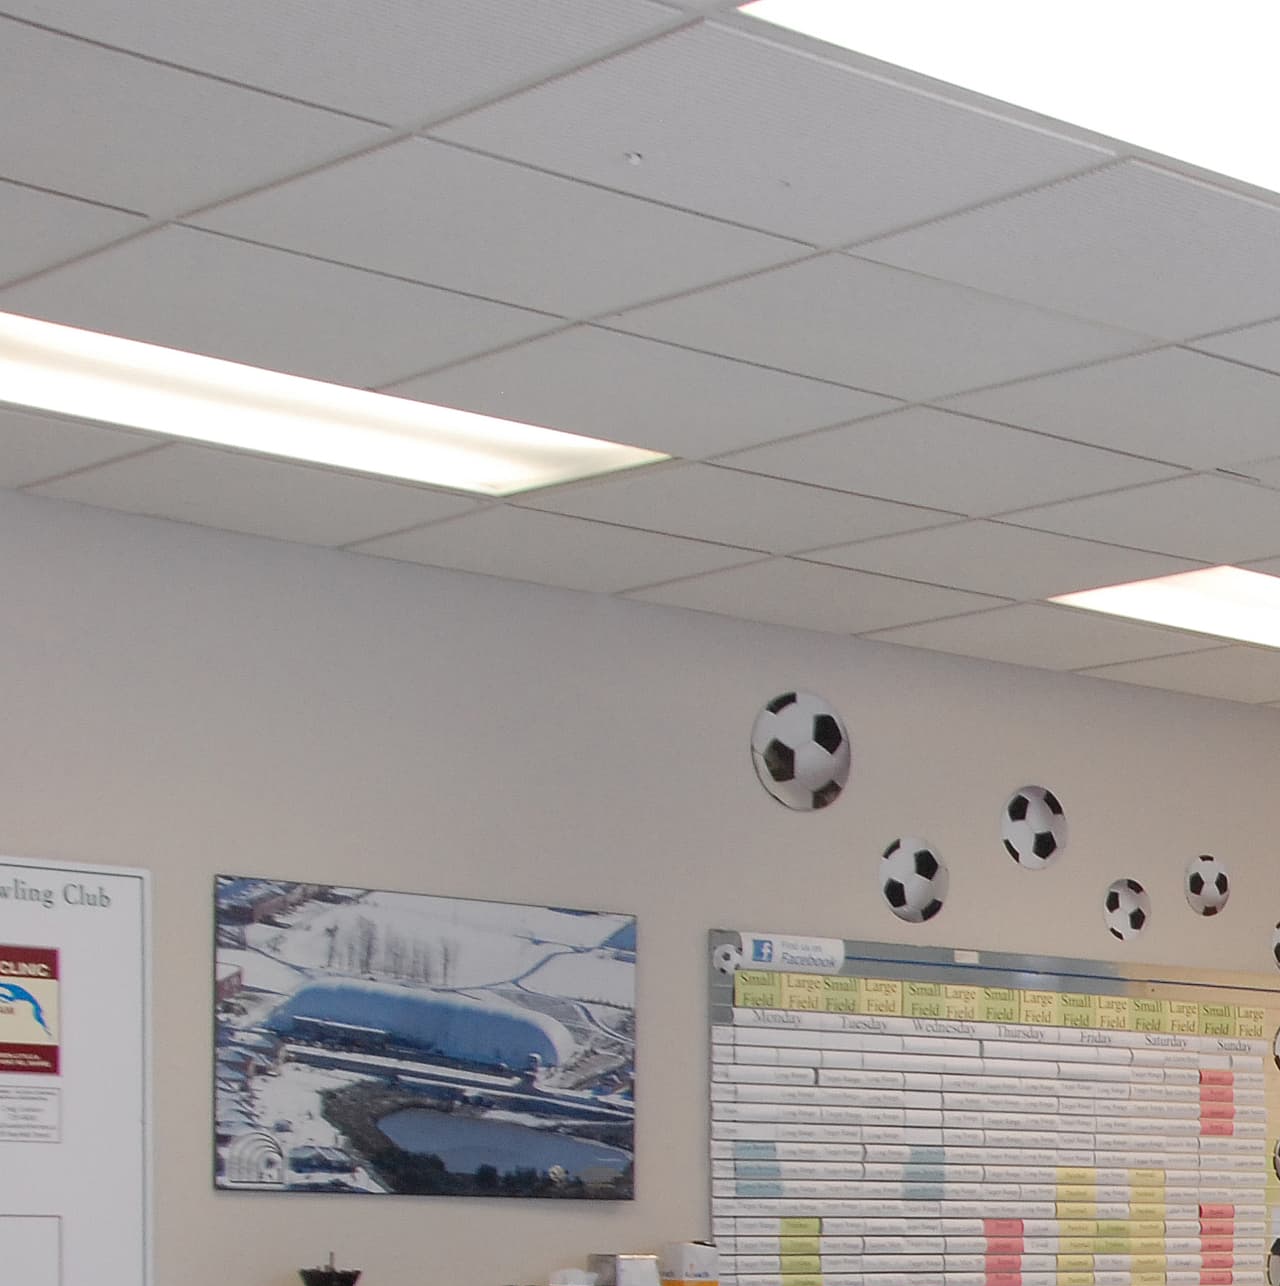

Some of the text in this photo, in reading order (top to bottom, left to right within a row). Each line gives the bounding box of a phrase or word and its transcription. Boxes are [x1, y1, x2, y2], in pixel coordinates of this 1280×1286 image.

[63, 883, 111, 908] Club
[781, 952, 835, 967] Facebook
[740, 973, 774, 986] Small
[787, 975, 821, 992] Large
[823, 979, 857, 992] Small
[866, 979, 897, 994] Large
[909, 982, 940, 997] Small
[743, 994, 774, 1007] Field
[944, 987, 976, 1002] Large
[984, 987, 1015, 1001] Small
[1024, 990, 1053, 1007] Large
[789, 995, 818, 1009] Field
[825, 998, 856, 1011] Field
[867, 1000, 896, 1012] Field
[1062, 995, 1091, 1009] Small
[1099, 997, 1127, 1012] Large
[1134, 1000, 1162, 1012] Small
[1170, 1001, 1197, 1016] Large
[911, 1004, 940, 1016] Field
[946, 1006, 975, 1019] Field
[986, 1008, 1013, 1021] Field
[1024, 1009, 1051, 1023] Field
[1203, 1004, 1231, 1017] Small
[1238, 1007, 1264, 1020] Large
[752, 1010, 801, 1028] Monday
[840, 1015, 887, 1033] Tuesday
[1063, 1014, 1089, 1027] Field
[1101, 1015, 1126, 1028] Field
[1135, 1018, 1161, 1031] Field
[912, 1019, 976, 1036] Wednesday
[1171, 1020, 1196, 1032] Field
[1204, 1023, 1229, 1036] Field
[1239, 1024, 1263, 1037] Field
[997, 1025, 1045, 1041] Thursday
[1080, 1033, 1112, 1046] Friday
[1145, 1036, 1187, 1050] Saturday
[1217, 1040, 1251, 1052] Sunday
